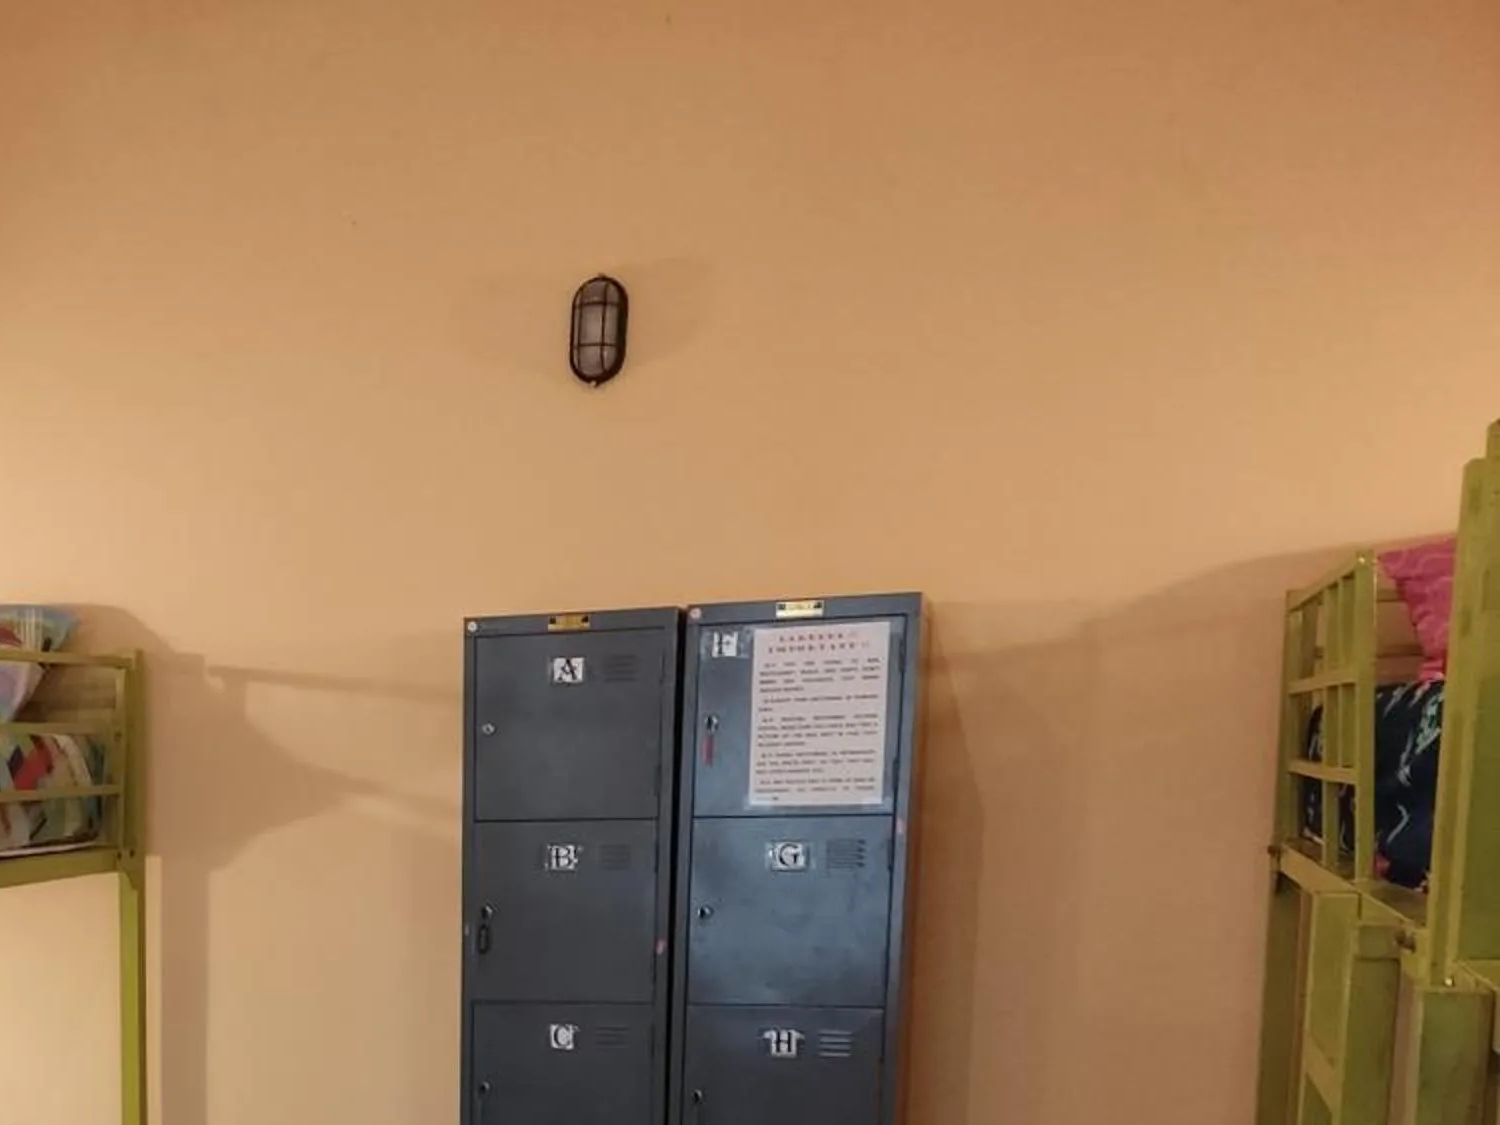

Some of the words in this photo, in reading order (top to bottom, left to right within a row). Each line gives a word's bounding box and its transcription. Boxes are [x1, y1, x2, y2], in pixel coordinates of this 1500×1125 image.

[557, 658, 579, 682] A
[554, 847, 575, 868] B
[778, 843, 801, 868] G
[552, 1025, 573, 1048] C
[773, 1030, 796, 1054] H
